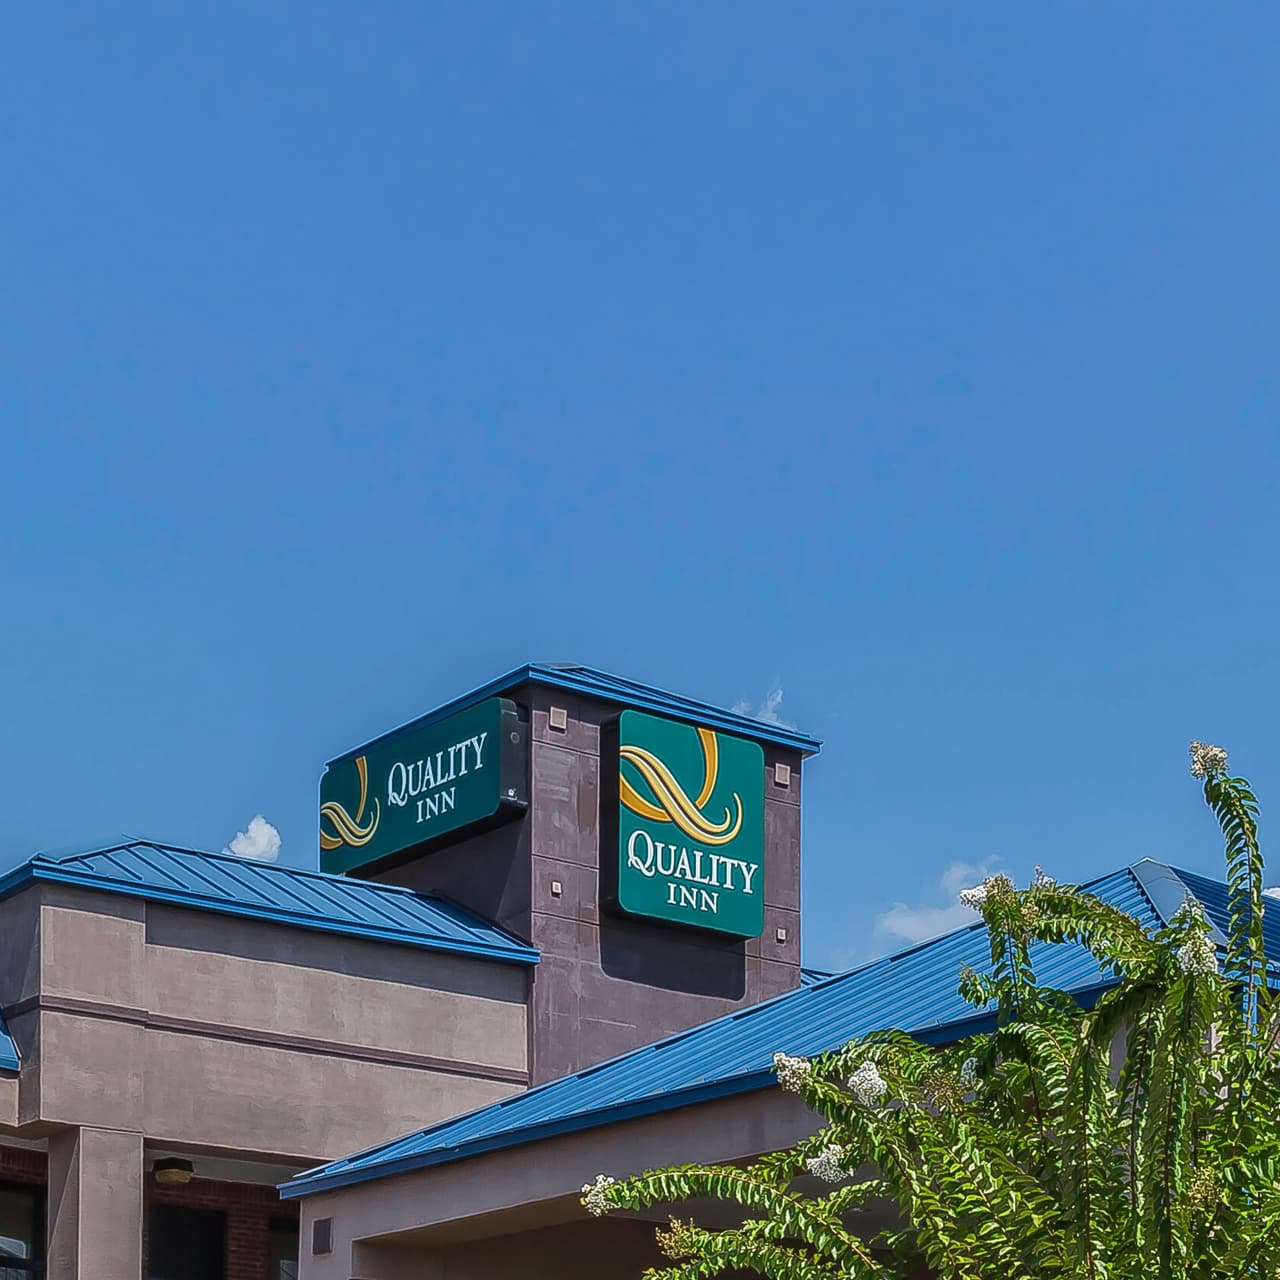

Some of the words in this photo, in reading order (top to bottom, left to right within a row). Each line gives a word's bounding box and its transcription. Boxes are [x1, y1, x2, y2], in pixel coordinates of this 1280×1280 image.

[388, 732, 487, 806] QUALITY
[416, 787, 456, 823] INN
[628, 830, 758, 894] QUALITY
[667, 882, 719, 914] INN
